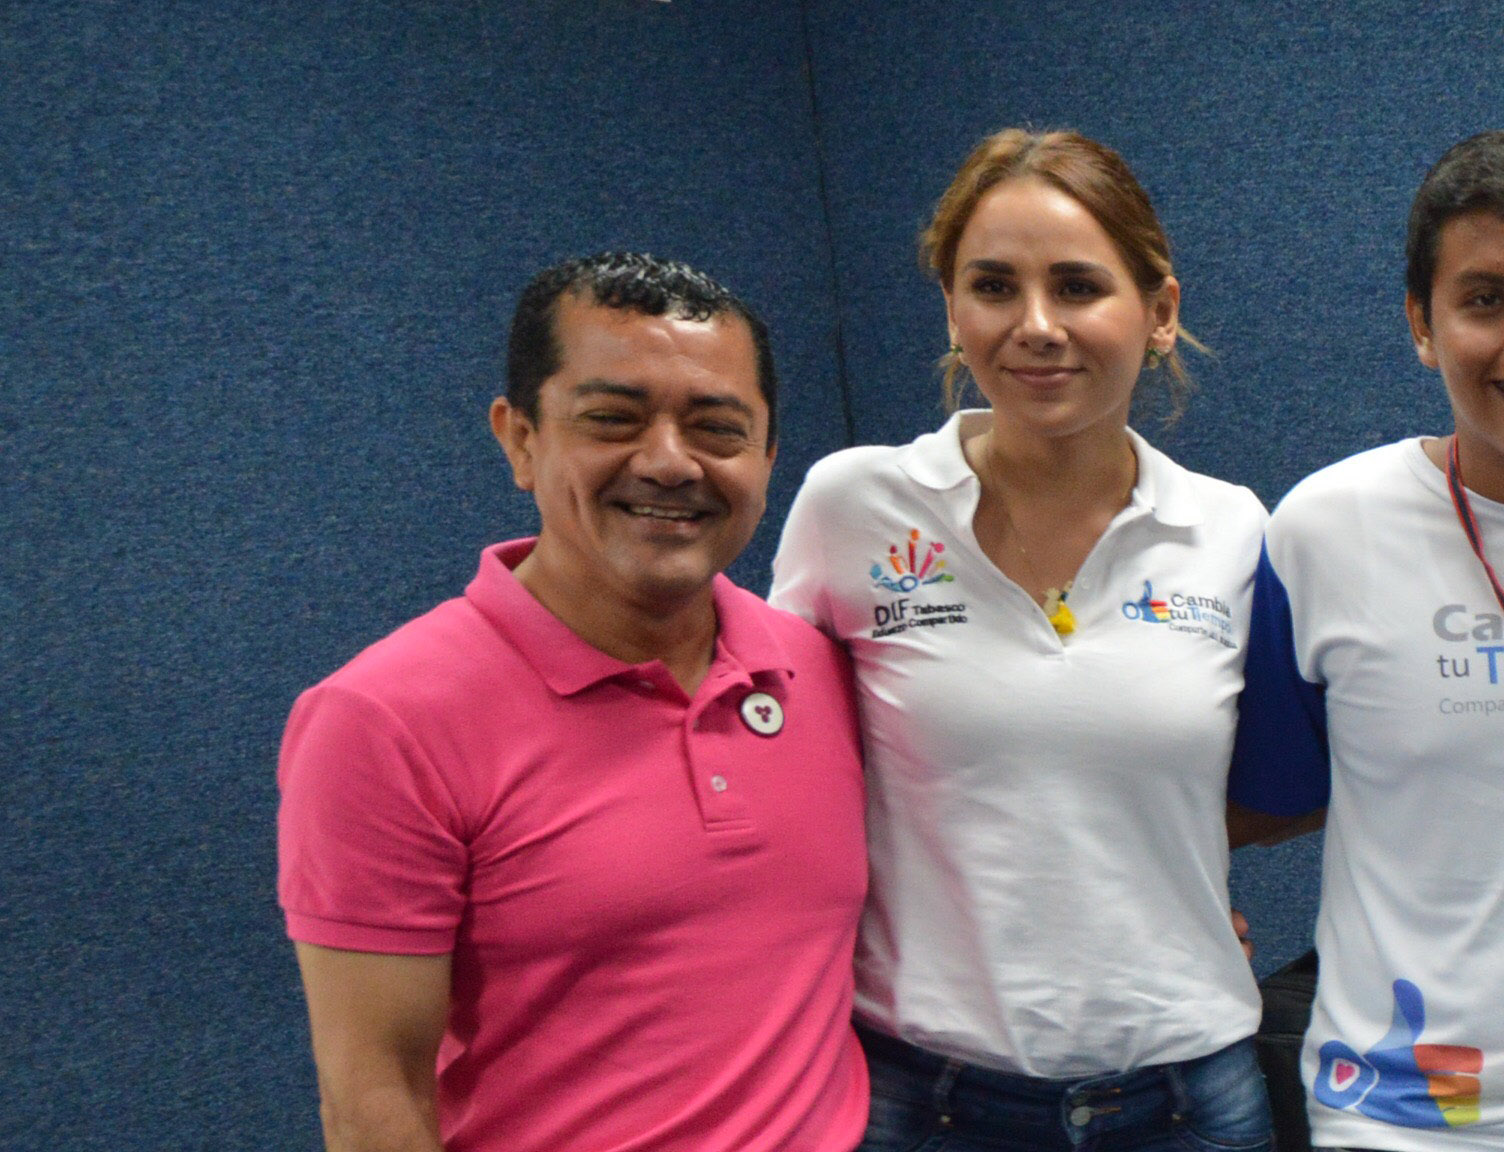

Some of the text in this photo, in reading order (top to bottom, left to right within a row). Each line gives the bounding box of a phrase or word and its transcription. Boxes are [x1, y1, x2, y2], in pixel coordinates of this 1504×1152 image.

[874, 598, 910, 627] DIF
[1169, 608, 1188, 620] tu
[1171, 593, 1232, 618] Cambia
[1437, 654, 1470, 678] tu
